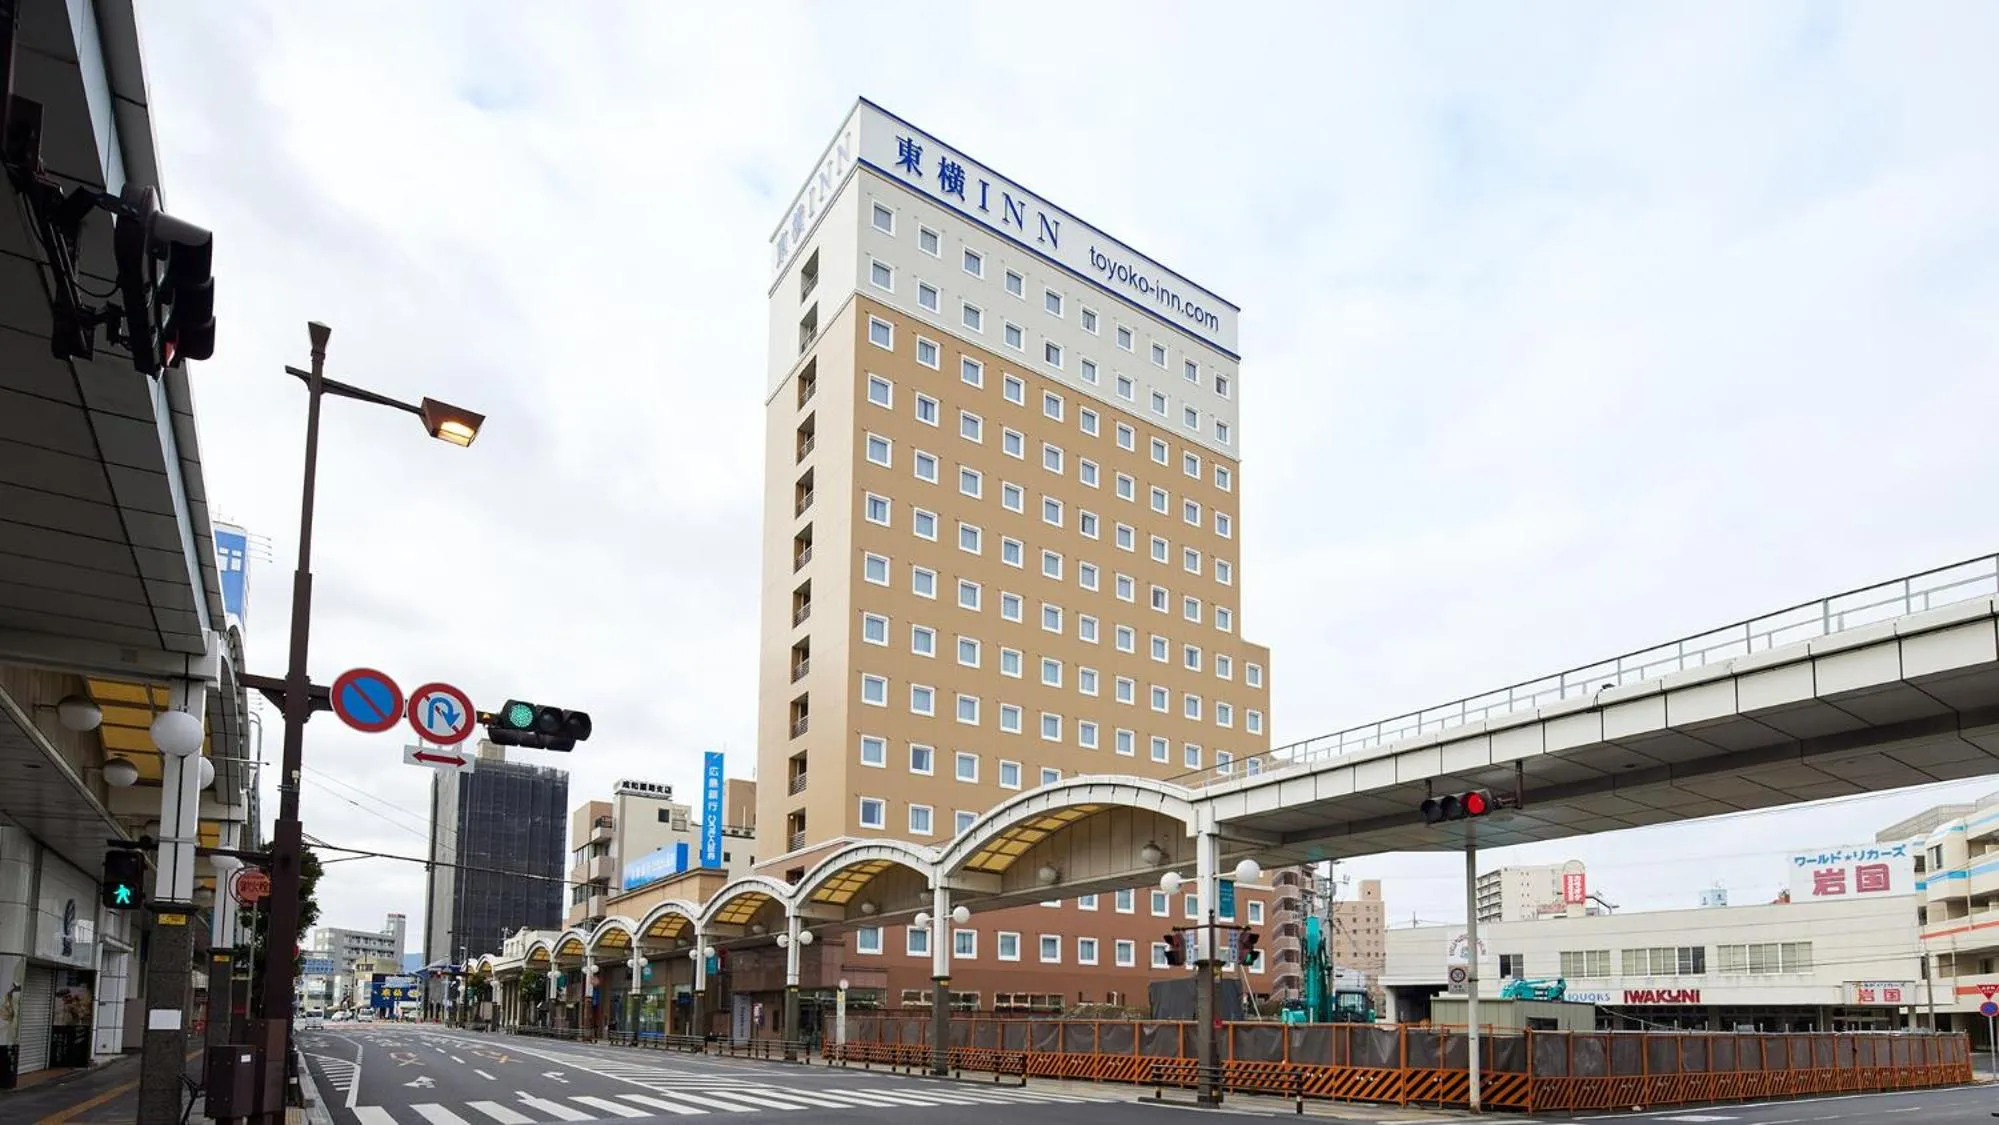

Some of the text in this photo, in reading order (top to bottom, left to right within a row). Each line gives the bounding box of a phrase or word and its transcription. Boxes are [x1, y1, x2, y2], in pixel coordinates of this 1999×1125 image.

[1089, 245, 1220, 333] toyoko-inn.com
[1812, 863, 1891, 896] 岩国
[1567, 989, 1701, 1004] IQUORS IWAKUNI
